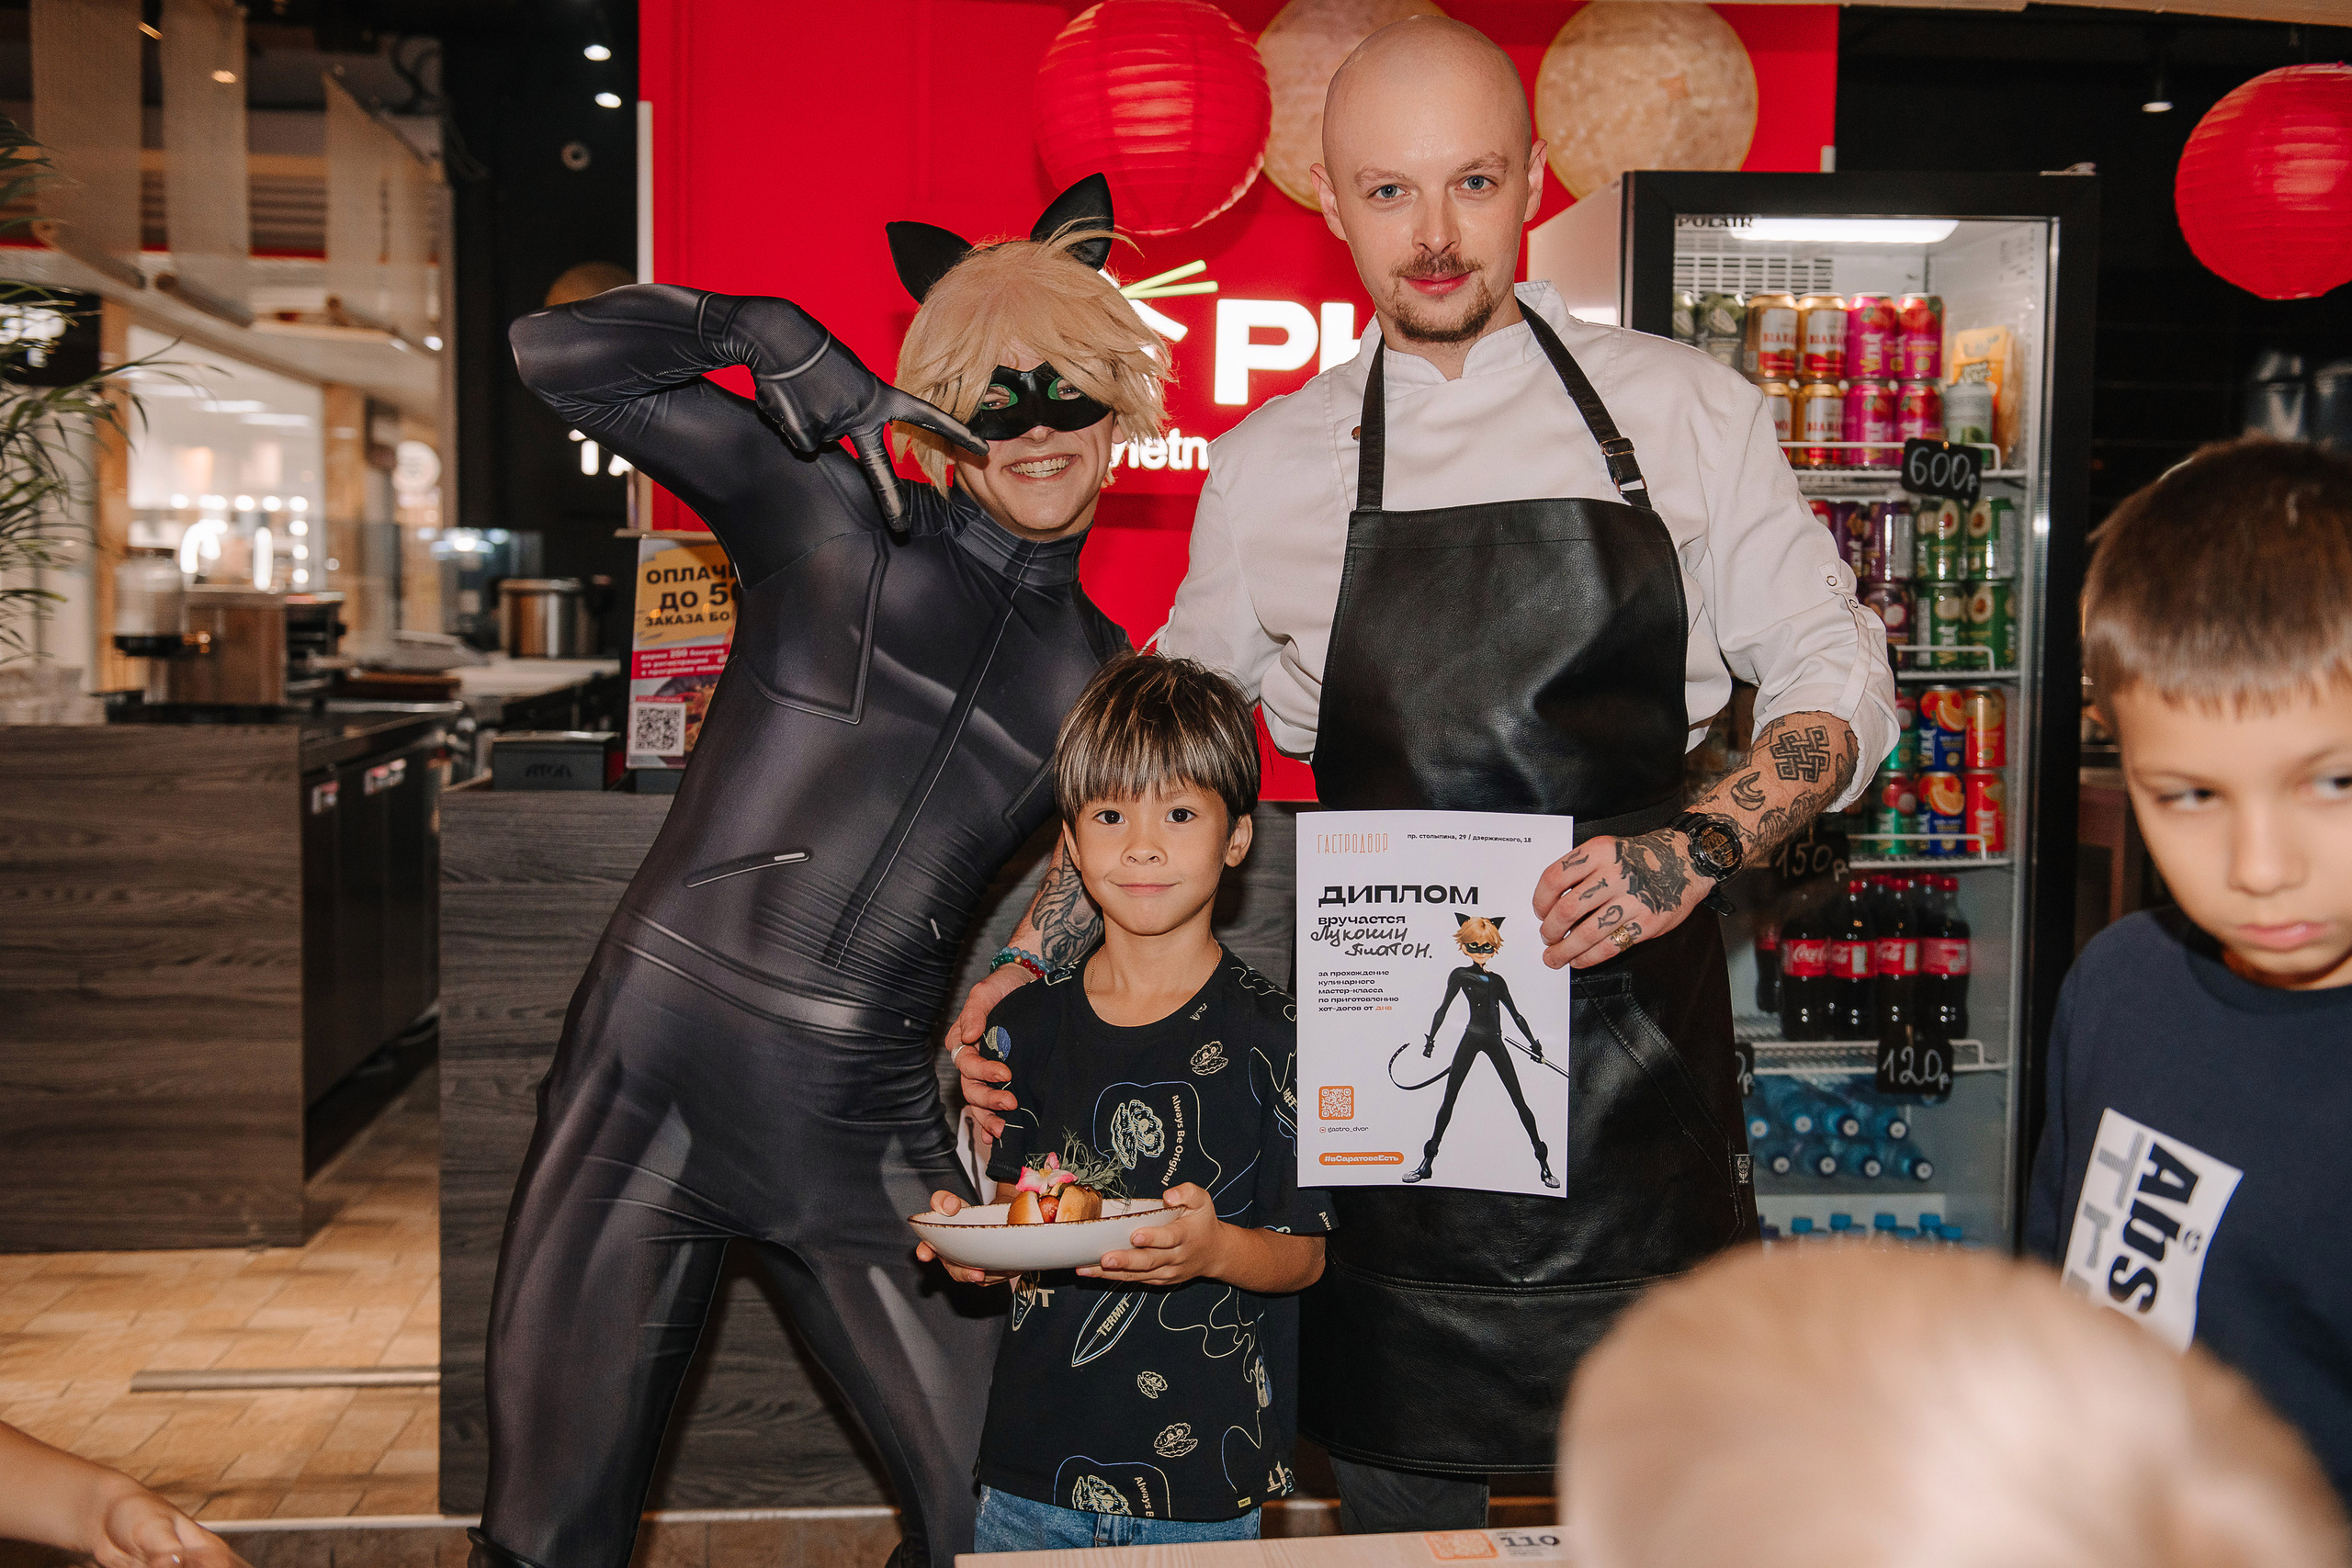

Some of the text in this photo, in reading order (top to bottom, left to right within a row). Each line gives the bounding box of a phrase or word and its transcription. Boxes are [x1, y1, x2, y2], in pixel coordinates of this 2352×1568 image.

[660, 582, 738, 612] ДО 5
[645, 611, 729, 626] ЗАКАЗА БО
[1317, 833, 1388, 854] ГАСТРОДВОР
[1473, 835, 1522, 843] дзержинского,
[1318, 915, 1406, 927] вручается
[1160, 1094, 1186, 1187] Always Be Original
[1324, 1155, 1399, 1163] #вСаратовеЕсть
[1096, 1296, 1131, 1337] TERMIT
[1134, 1476, 1152, 1510] Always
